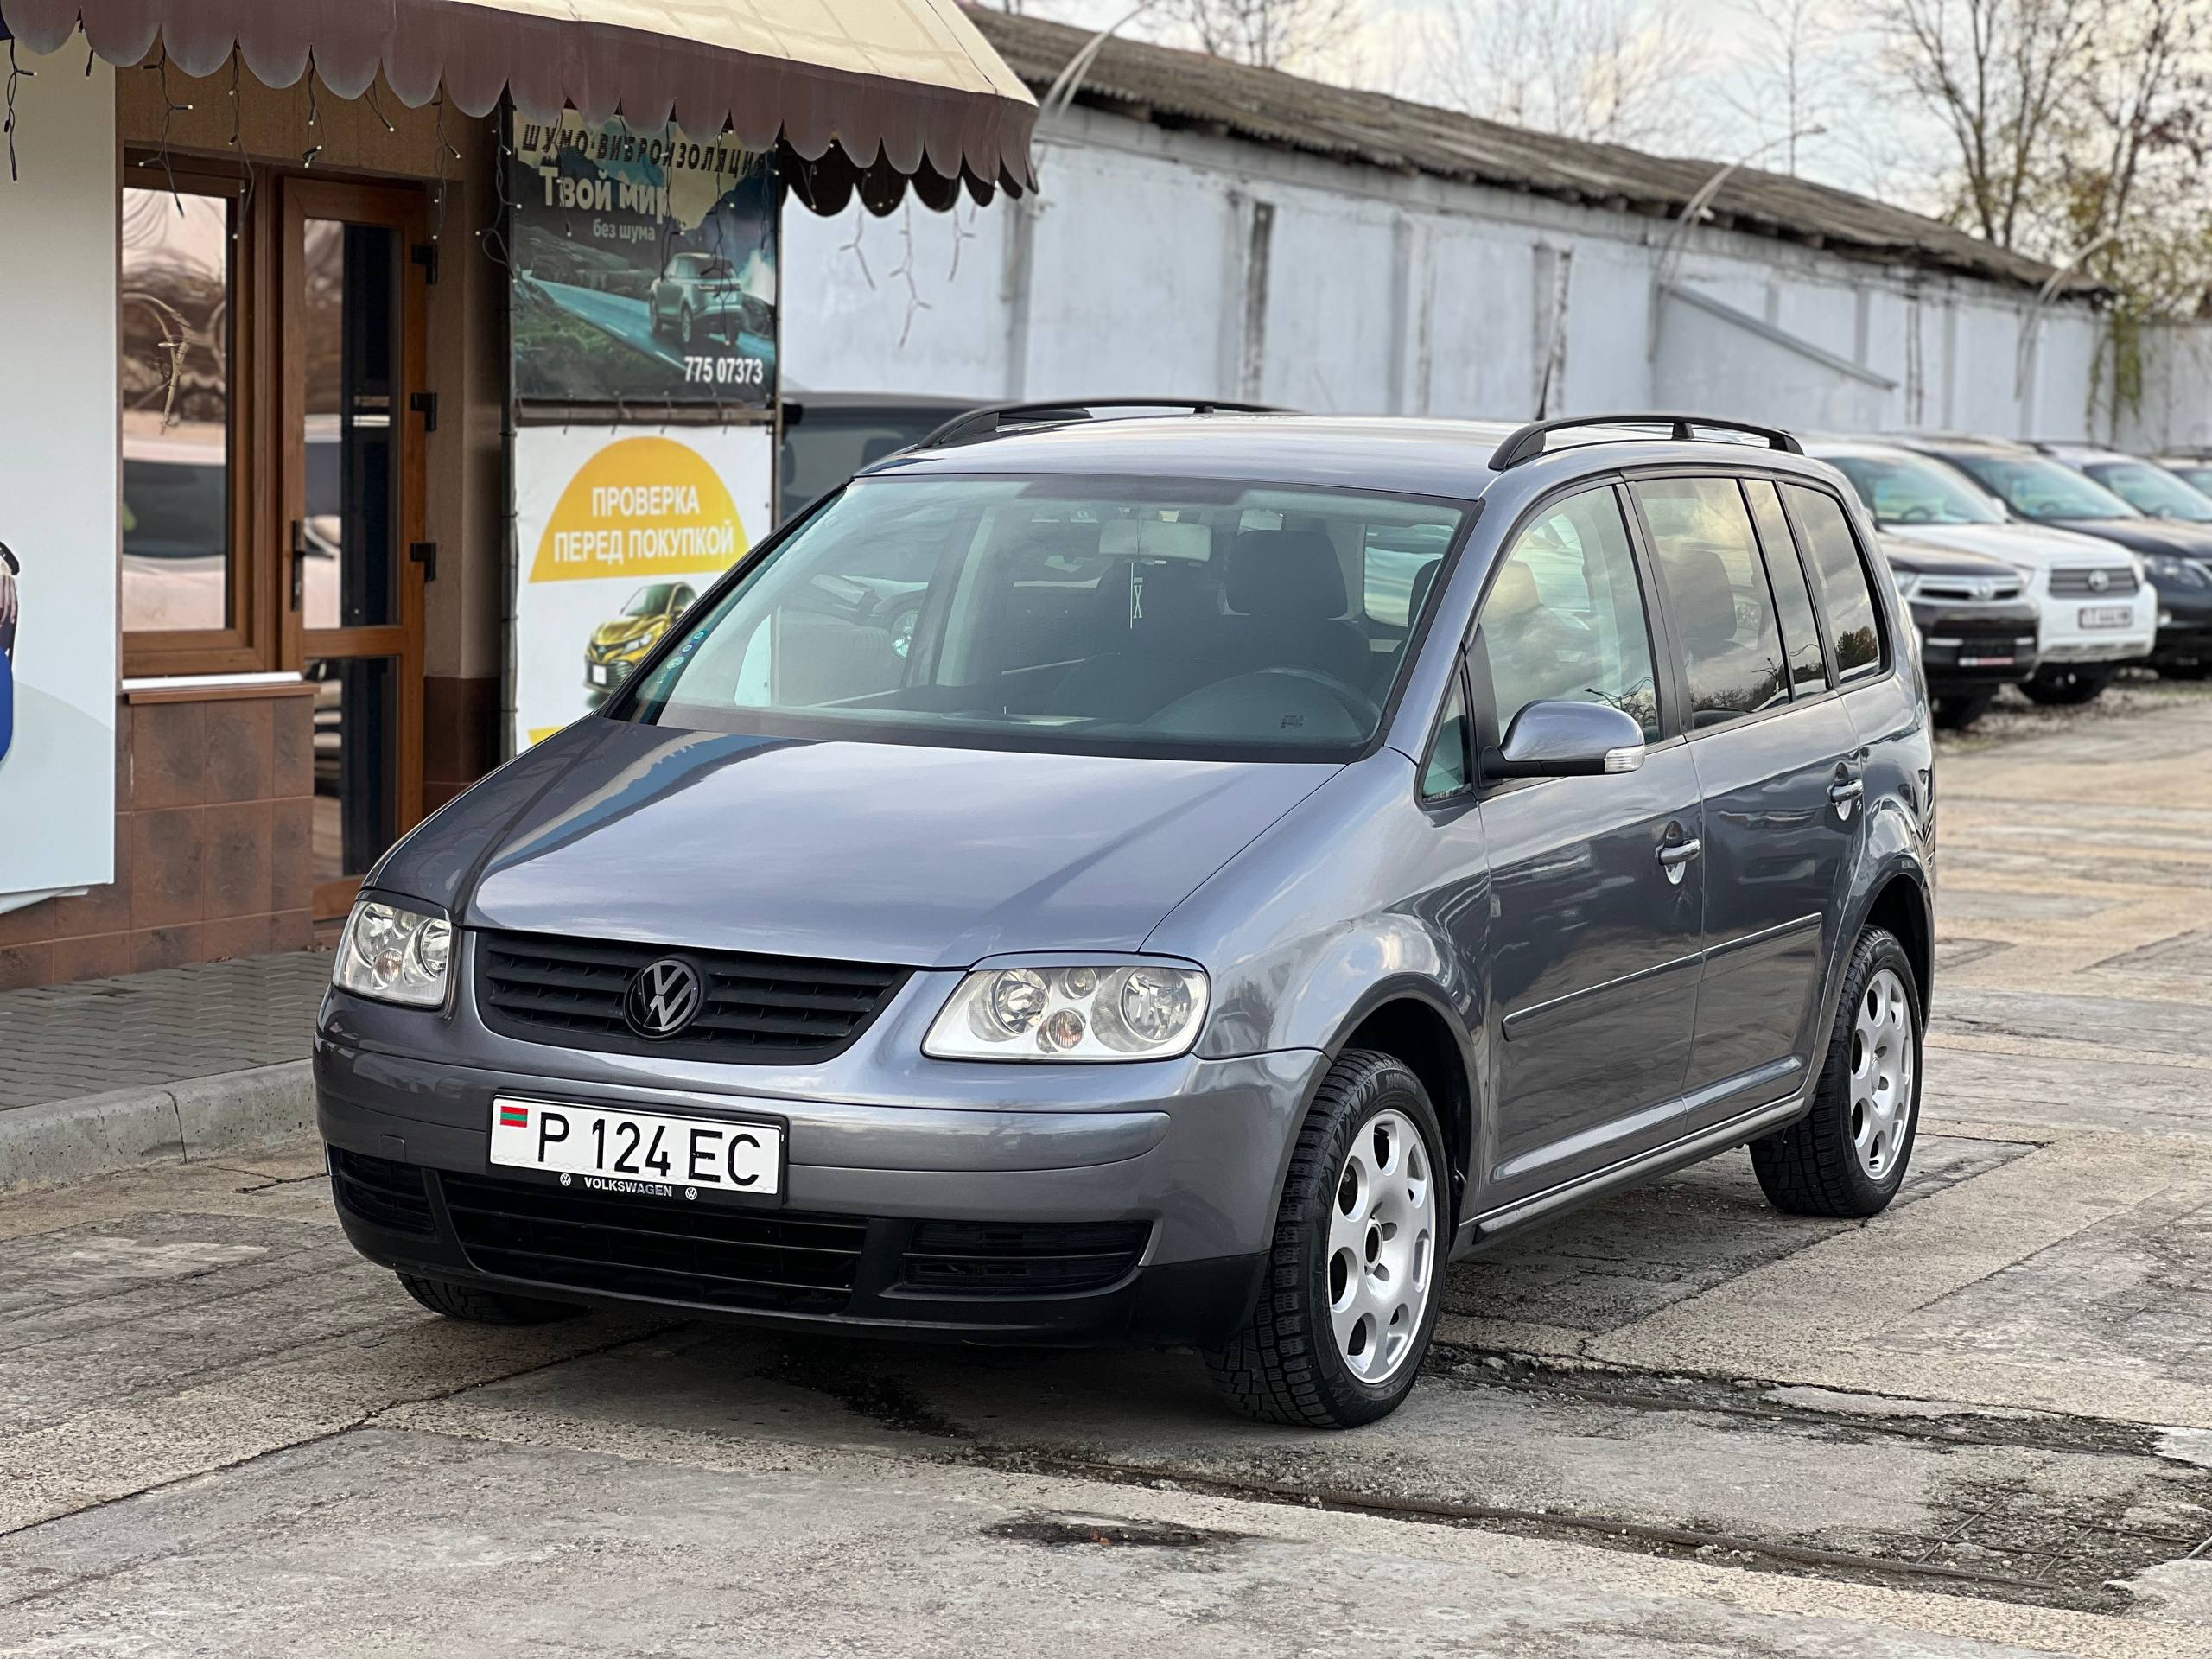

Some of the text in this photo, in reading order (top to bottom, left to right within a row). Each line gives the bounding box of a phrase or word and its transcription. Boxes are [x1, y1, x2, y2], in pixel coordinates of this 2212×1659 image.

[539, 166, 612, 212] Твой
[593, 218, 656, 244] без шума
[684, 355, 763, 384] 775 07373
[592, 485, 700, 517] ПРОВЕРКА
[554, 520, 734, 565] ПЕРЕД ПОКУПКОЙ
[537, 1111, 760, 1186] P 124 EC
[584, 1177, 672, 1197] VOLKSWAGEN
